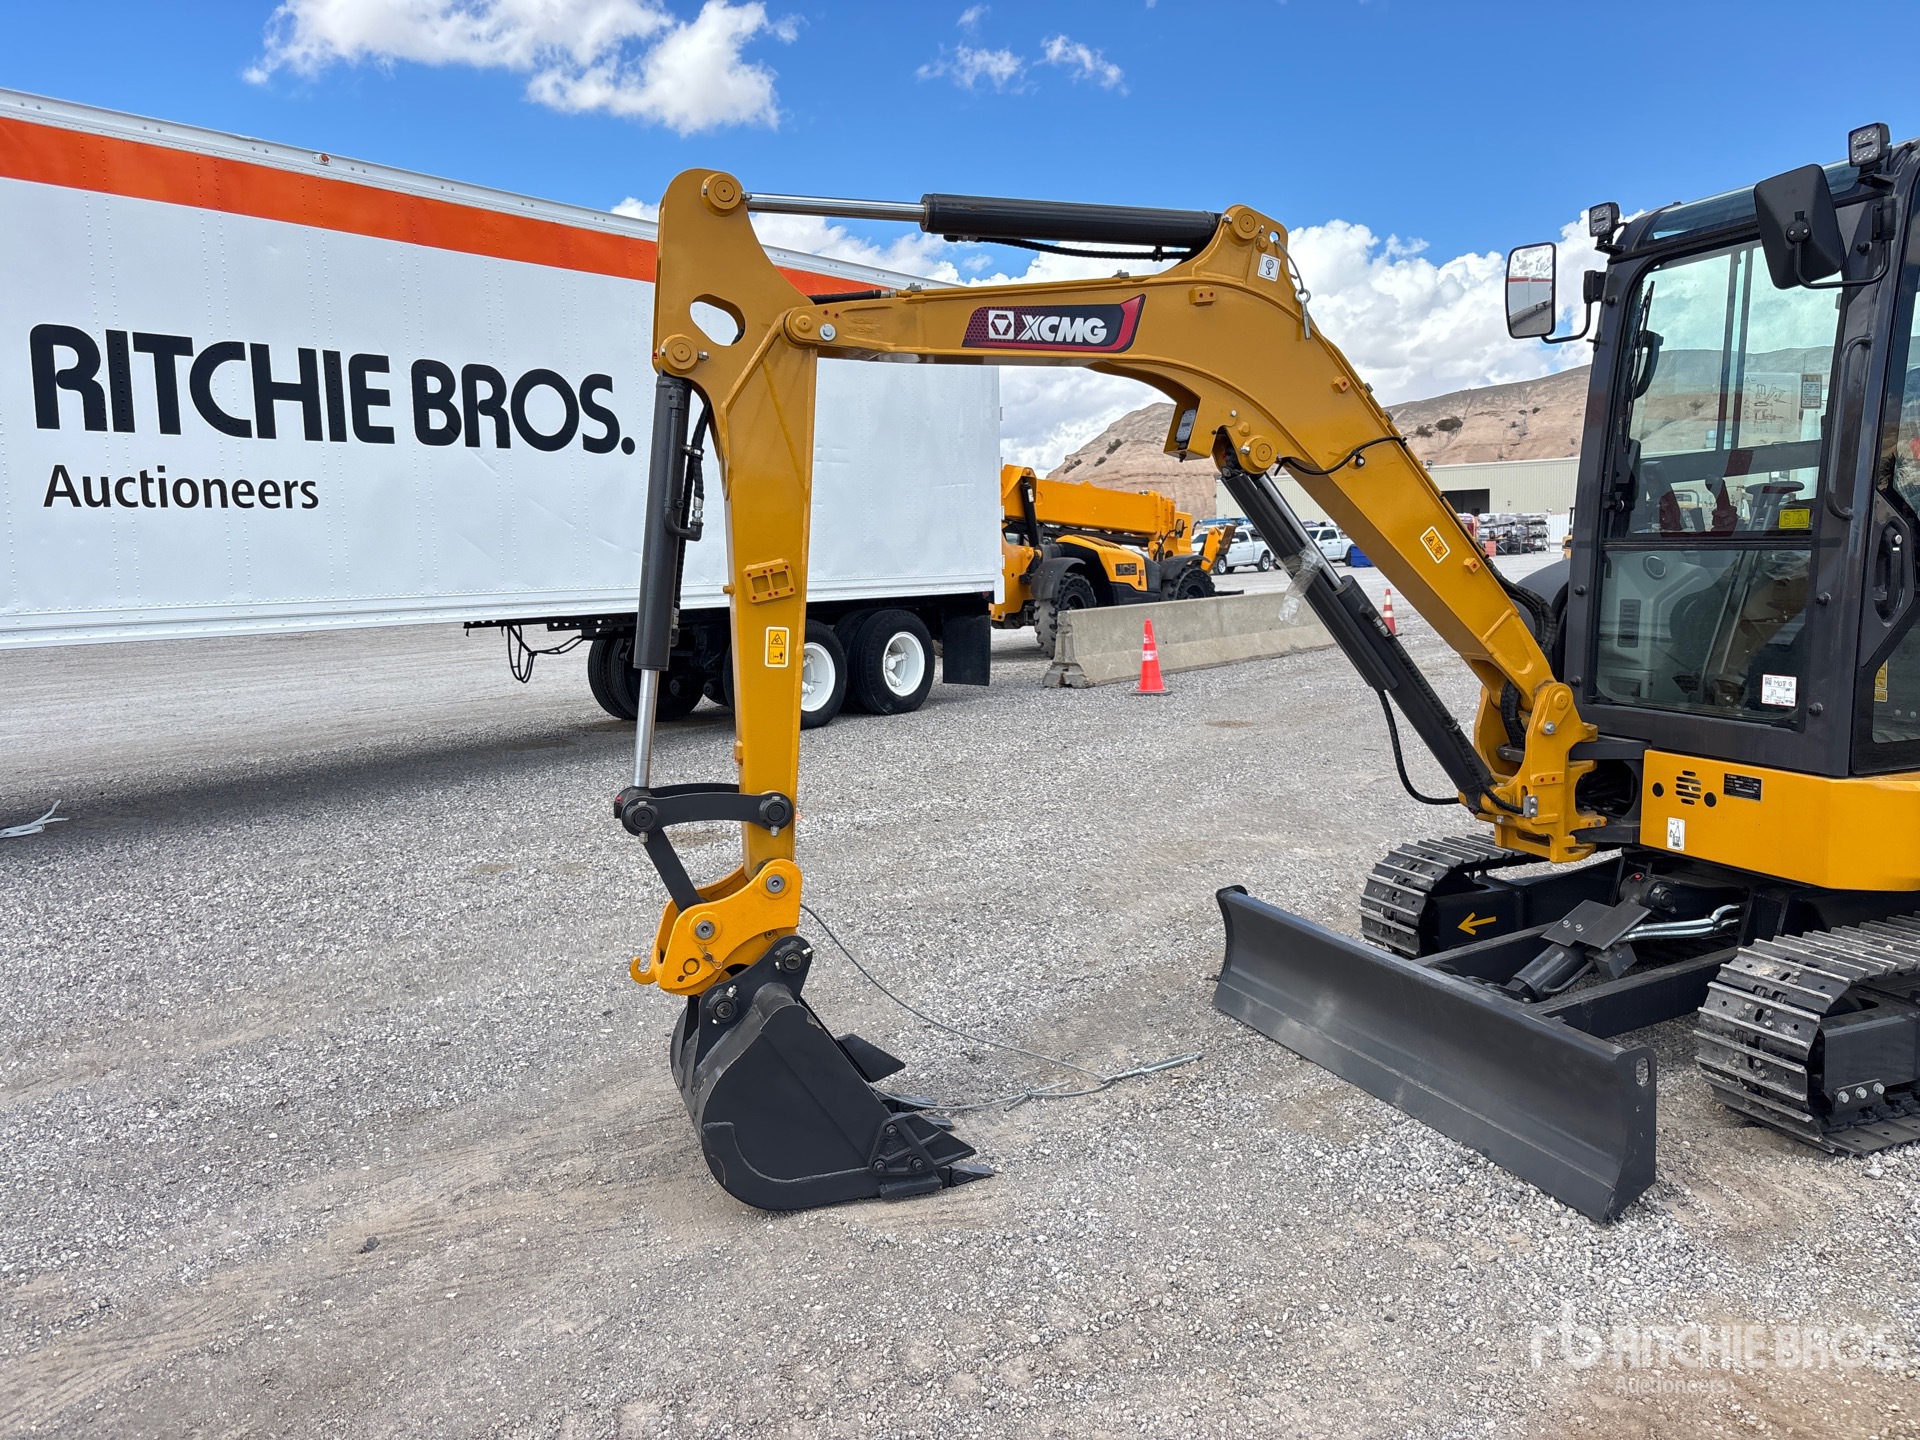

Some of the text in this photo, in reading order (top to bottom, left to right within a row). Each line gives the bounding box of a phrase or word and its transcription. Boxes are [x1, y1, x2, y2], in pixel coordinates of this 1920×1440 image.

[1016, 314, 1107, 344] XCMG
[29, 323, 636, 455] RITCHIE BROS.
[43, 464, 319, 509] Auctioneers
